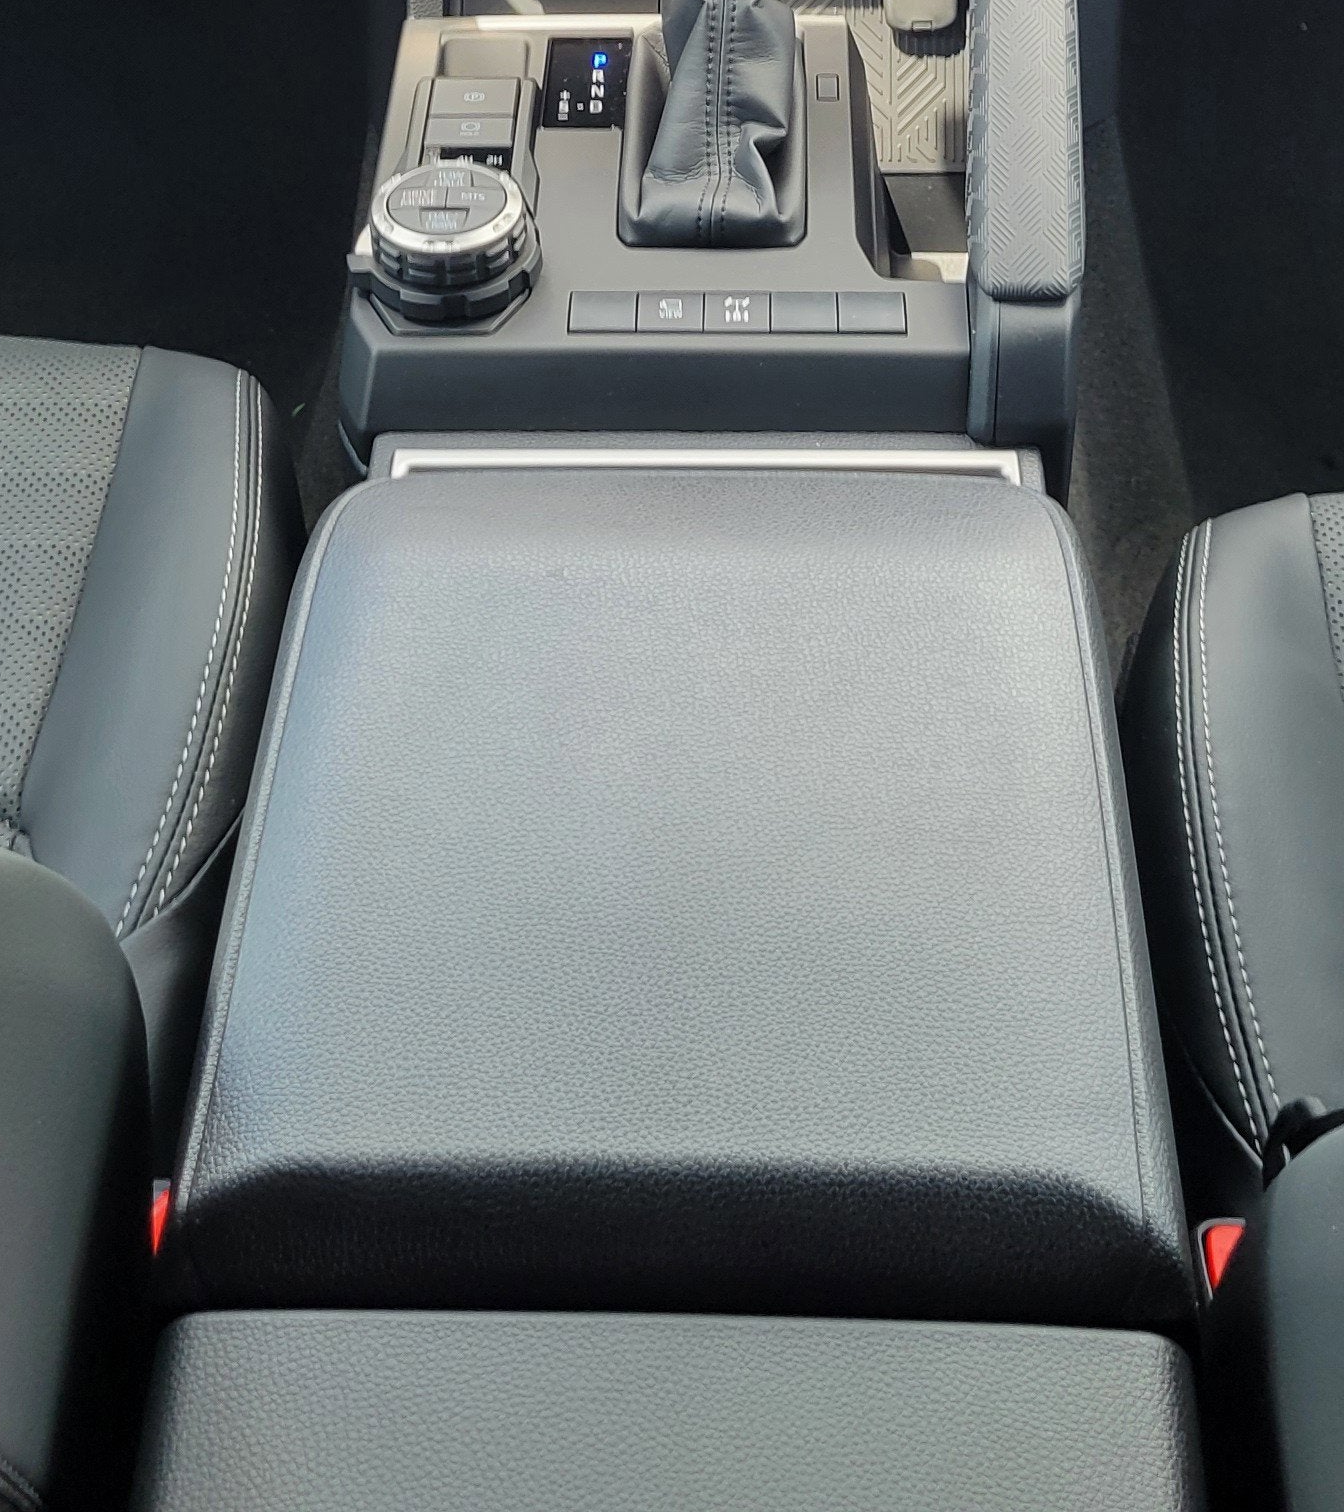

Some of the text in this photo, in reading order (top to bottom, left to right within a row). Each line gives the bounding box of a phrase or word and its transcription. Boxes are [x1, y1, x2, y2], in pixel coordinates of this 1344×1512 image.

[593, 52, 607, 69] P
[591, 68, 605, 84] R
[590, 84, 605, 99] N
[589, 99, 603, 114] D
